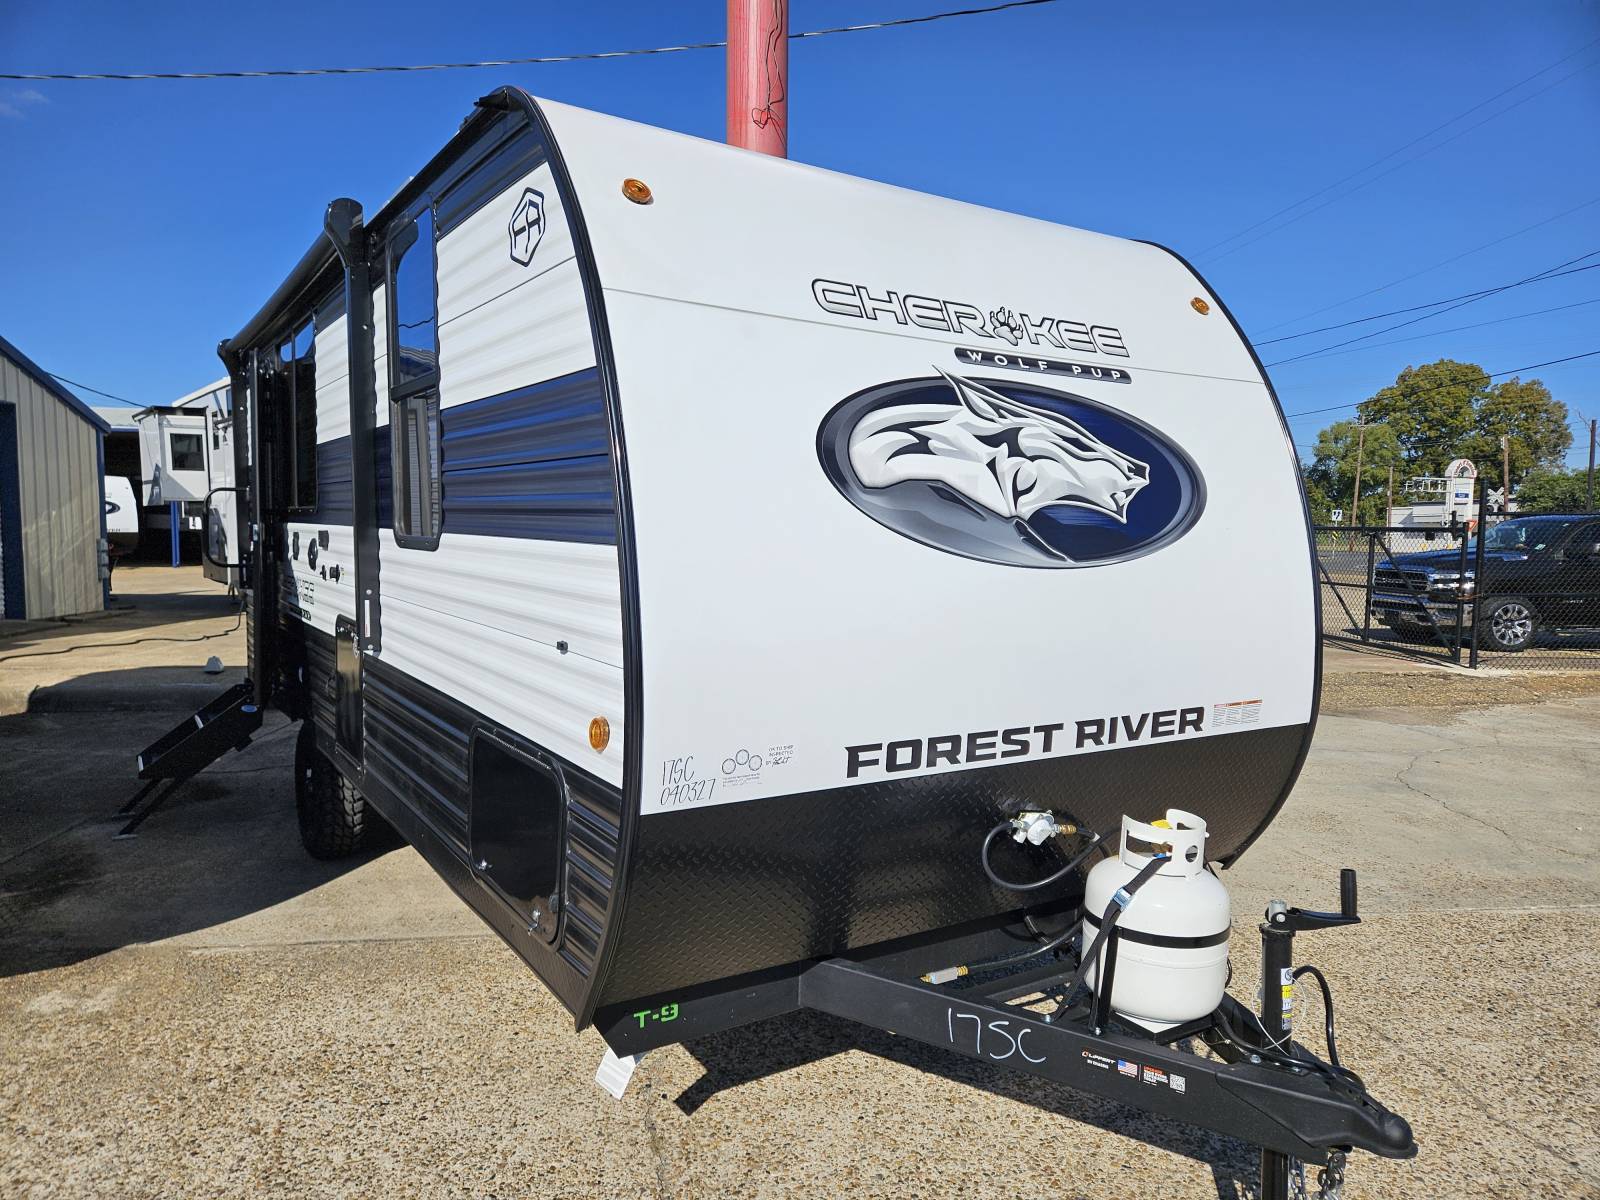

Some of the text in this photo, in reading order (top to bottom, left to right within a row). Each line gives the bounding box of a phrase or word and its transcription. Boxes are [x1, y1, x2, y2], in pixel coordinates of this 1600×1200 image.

[966, 350, 1122, 381] WOLF PUP
[844, 723, 1065, 778] FOREST
[1075, 706, 1205, 749] RIVER
[660, 778, 716, 806] 040327
[633, 1003, 679, 1028] T-9
